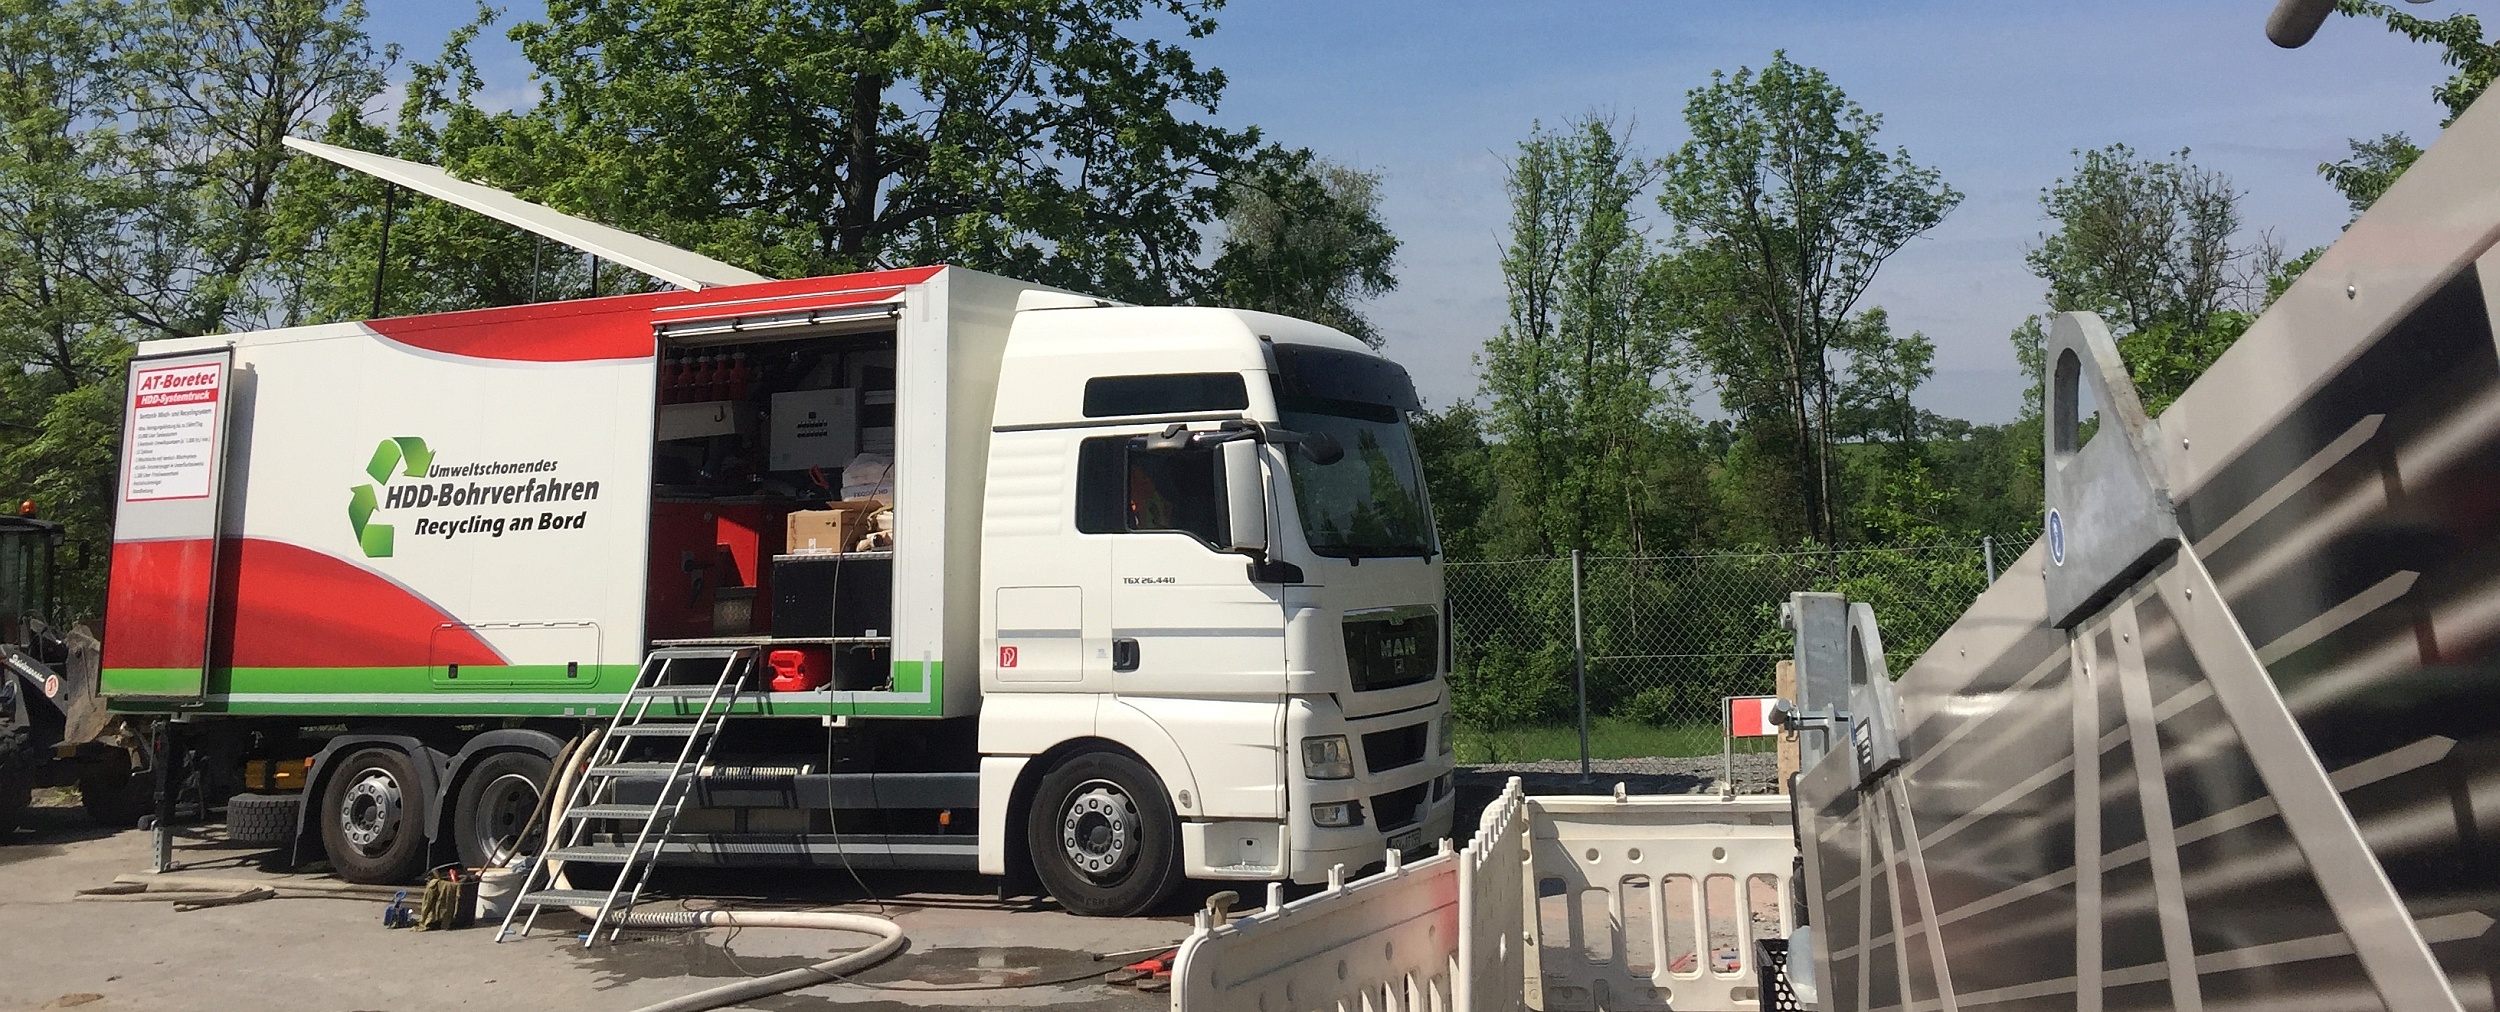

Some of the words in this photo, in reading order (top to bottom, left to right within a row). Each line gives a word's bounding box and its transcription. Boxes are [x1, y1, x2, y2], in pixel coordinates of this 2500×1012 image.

[140, 372, 216, 391] AT-Boretec
[141, 390, 210, 405] HDD-Systemtruck
[429, 459, 558, 478] Umweltschonendes
[384, 478, 600, 509] HDD-Bohrverfahren
[414, 515, 505, 540] Recycling
[508, 515, 534, 531] an
[537, 511, 587, 531] Bord
[1380, 636, 1416, 657] MAN
